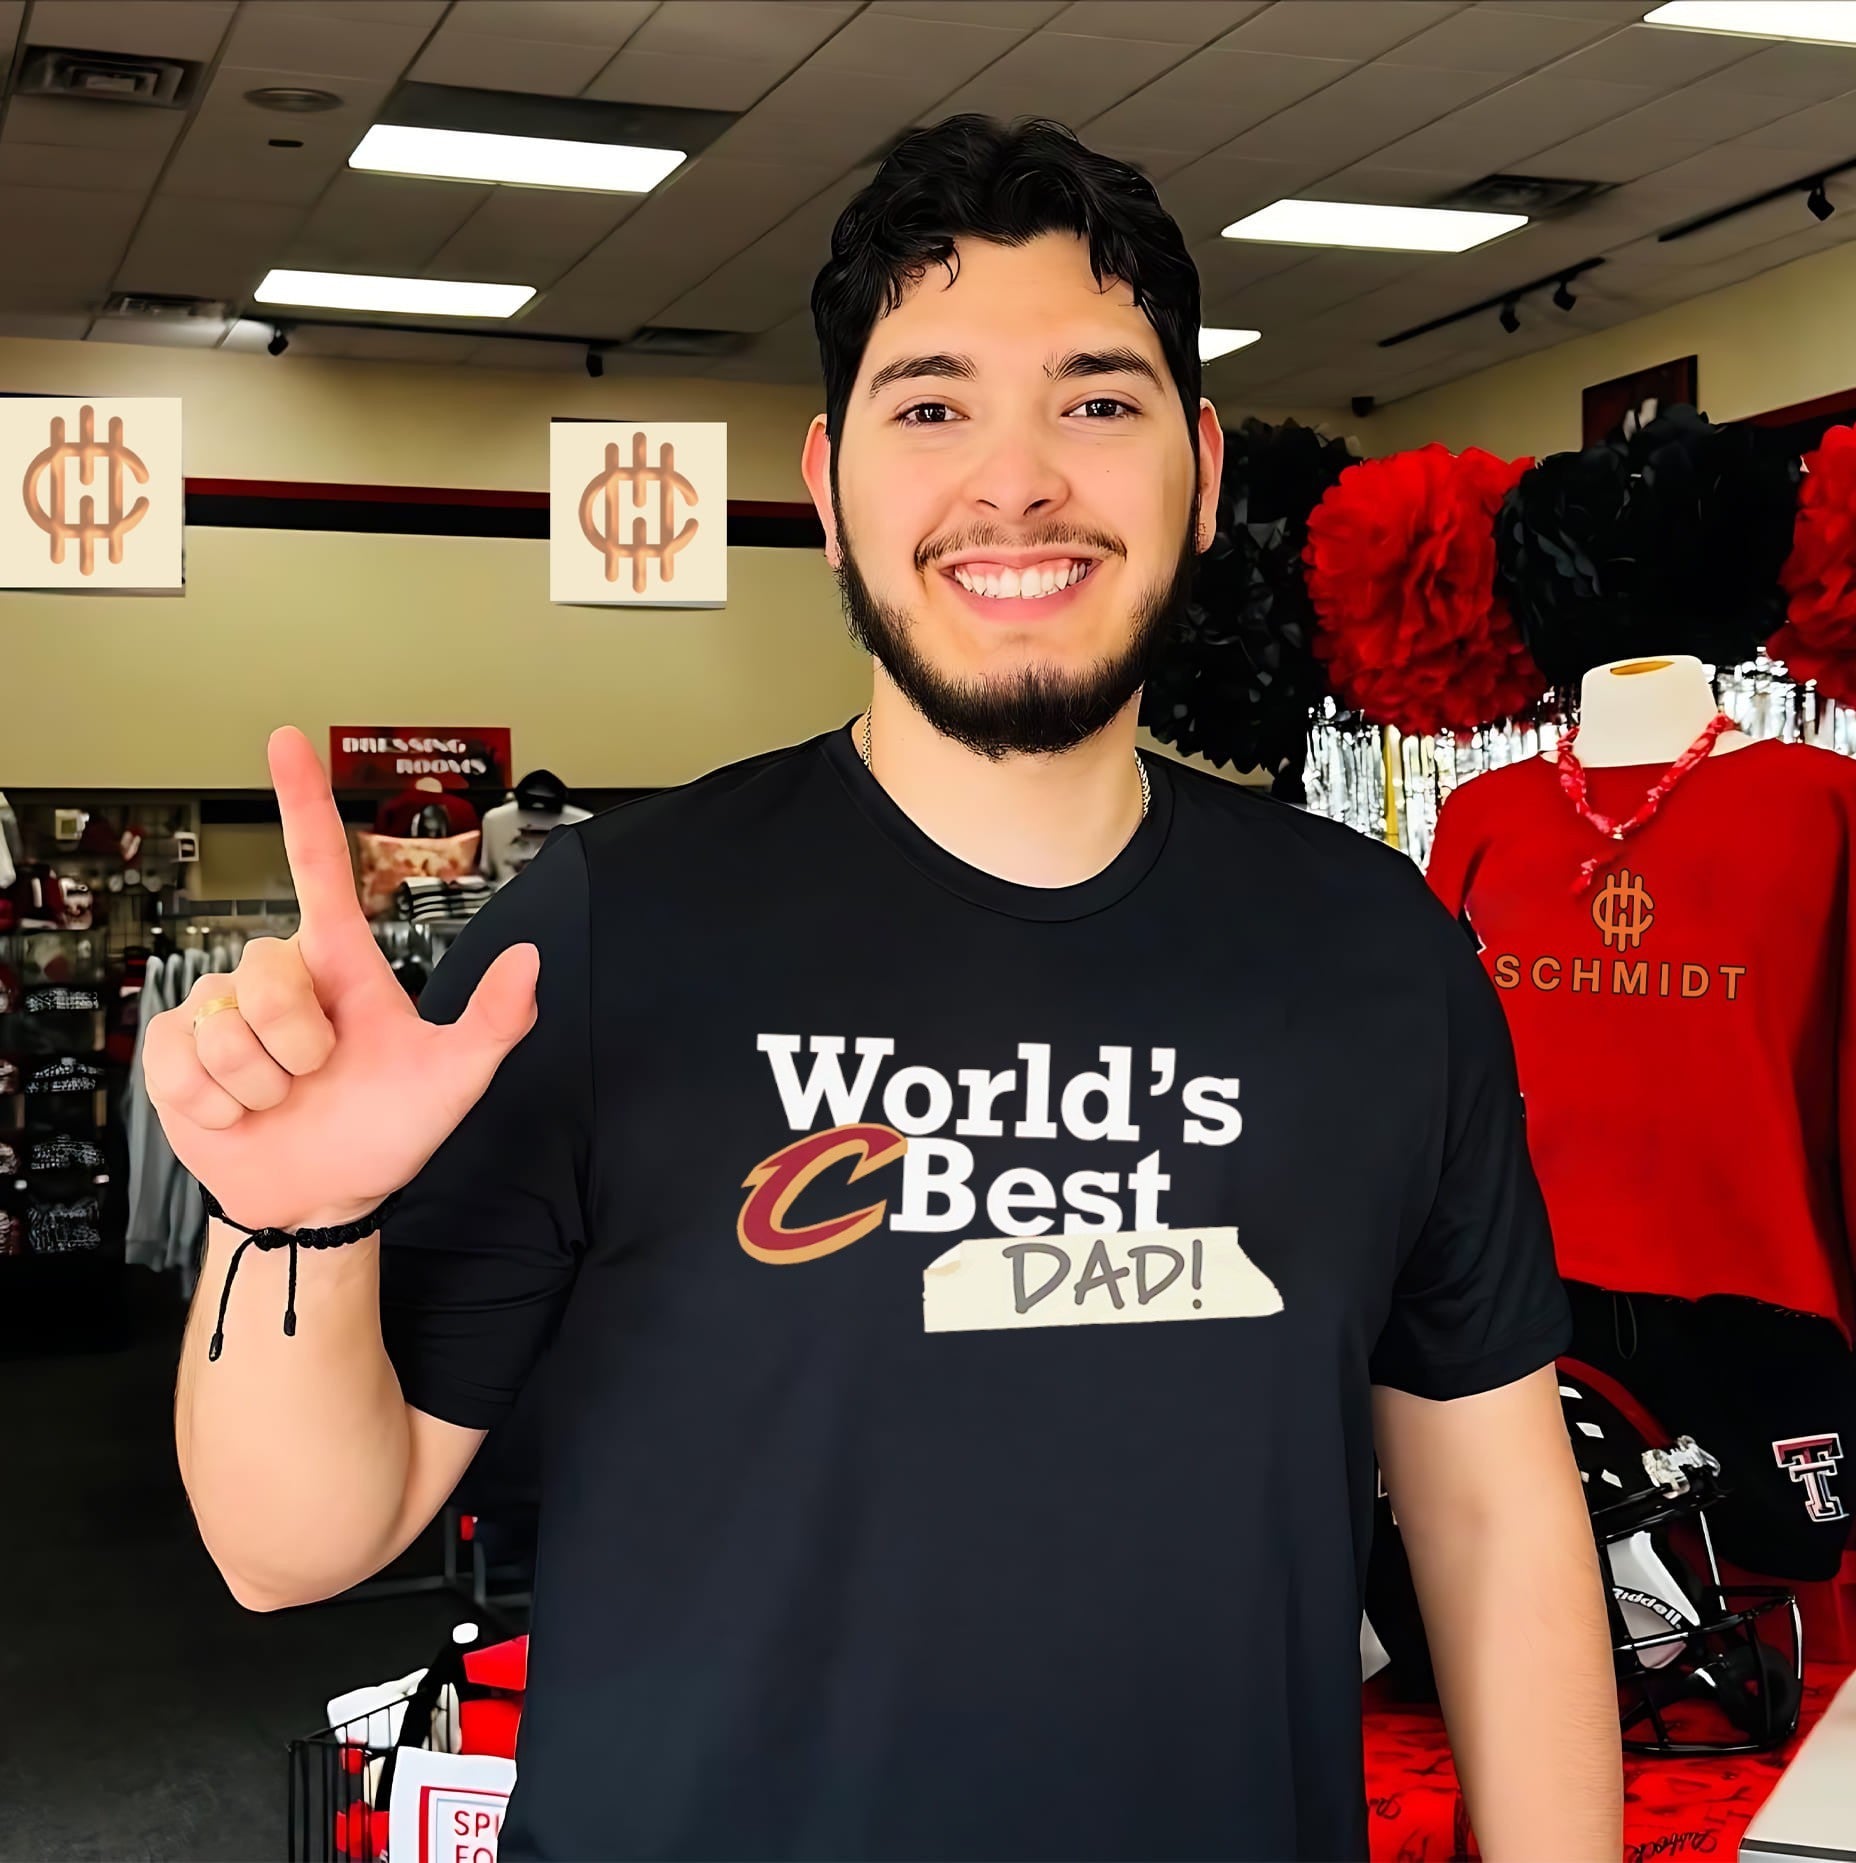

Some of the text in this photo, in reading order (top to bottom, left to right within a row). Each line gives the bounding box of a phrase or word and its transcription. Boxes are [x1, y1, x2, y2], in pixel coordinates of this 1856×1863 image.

[342, 737, 466, 753] DRESSING
[396, 759, 487, 775] ROOMS
[1494, 954, 1747, 1000] SCHMIDT
[757, 1033, 1242, 1146] World's
[889, 1136, 1170, 1236] Best
[1002, 1239, 1203, 1314] DAD!
